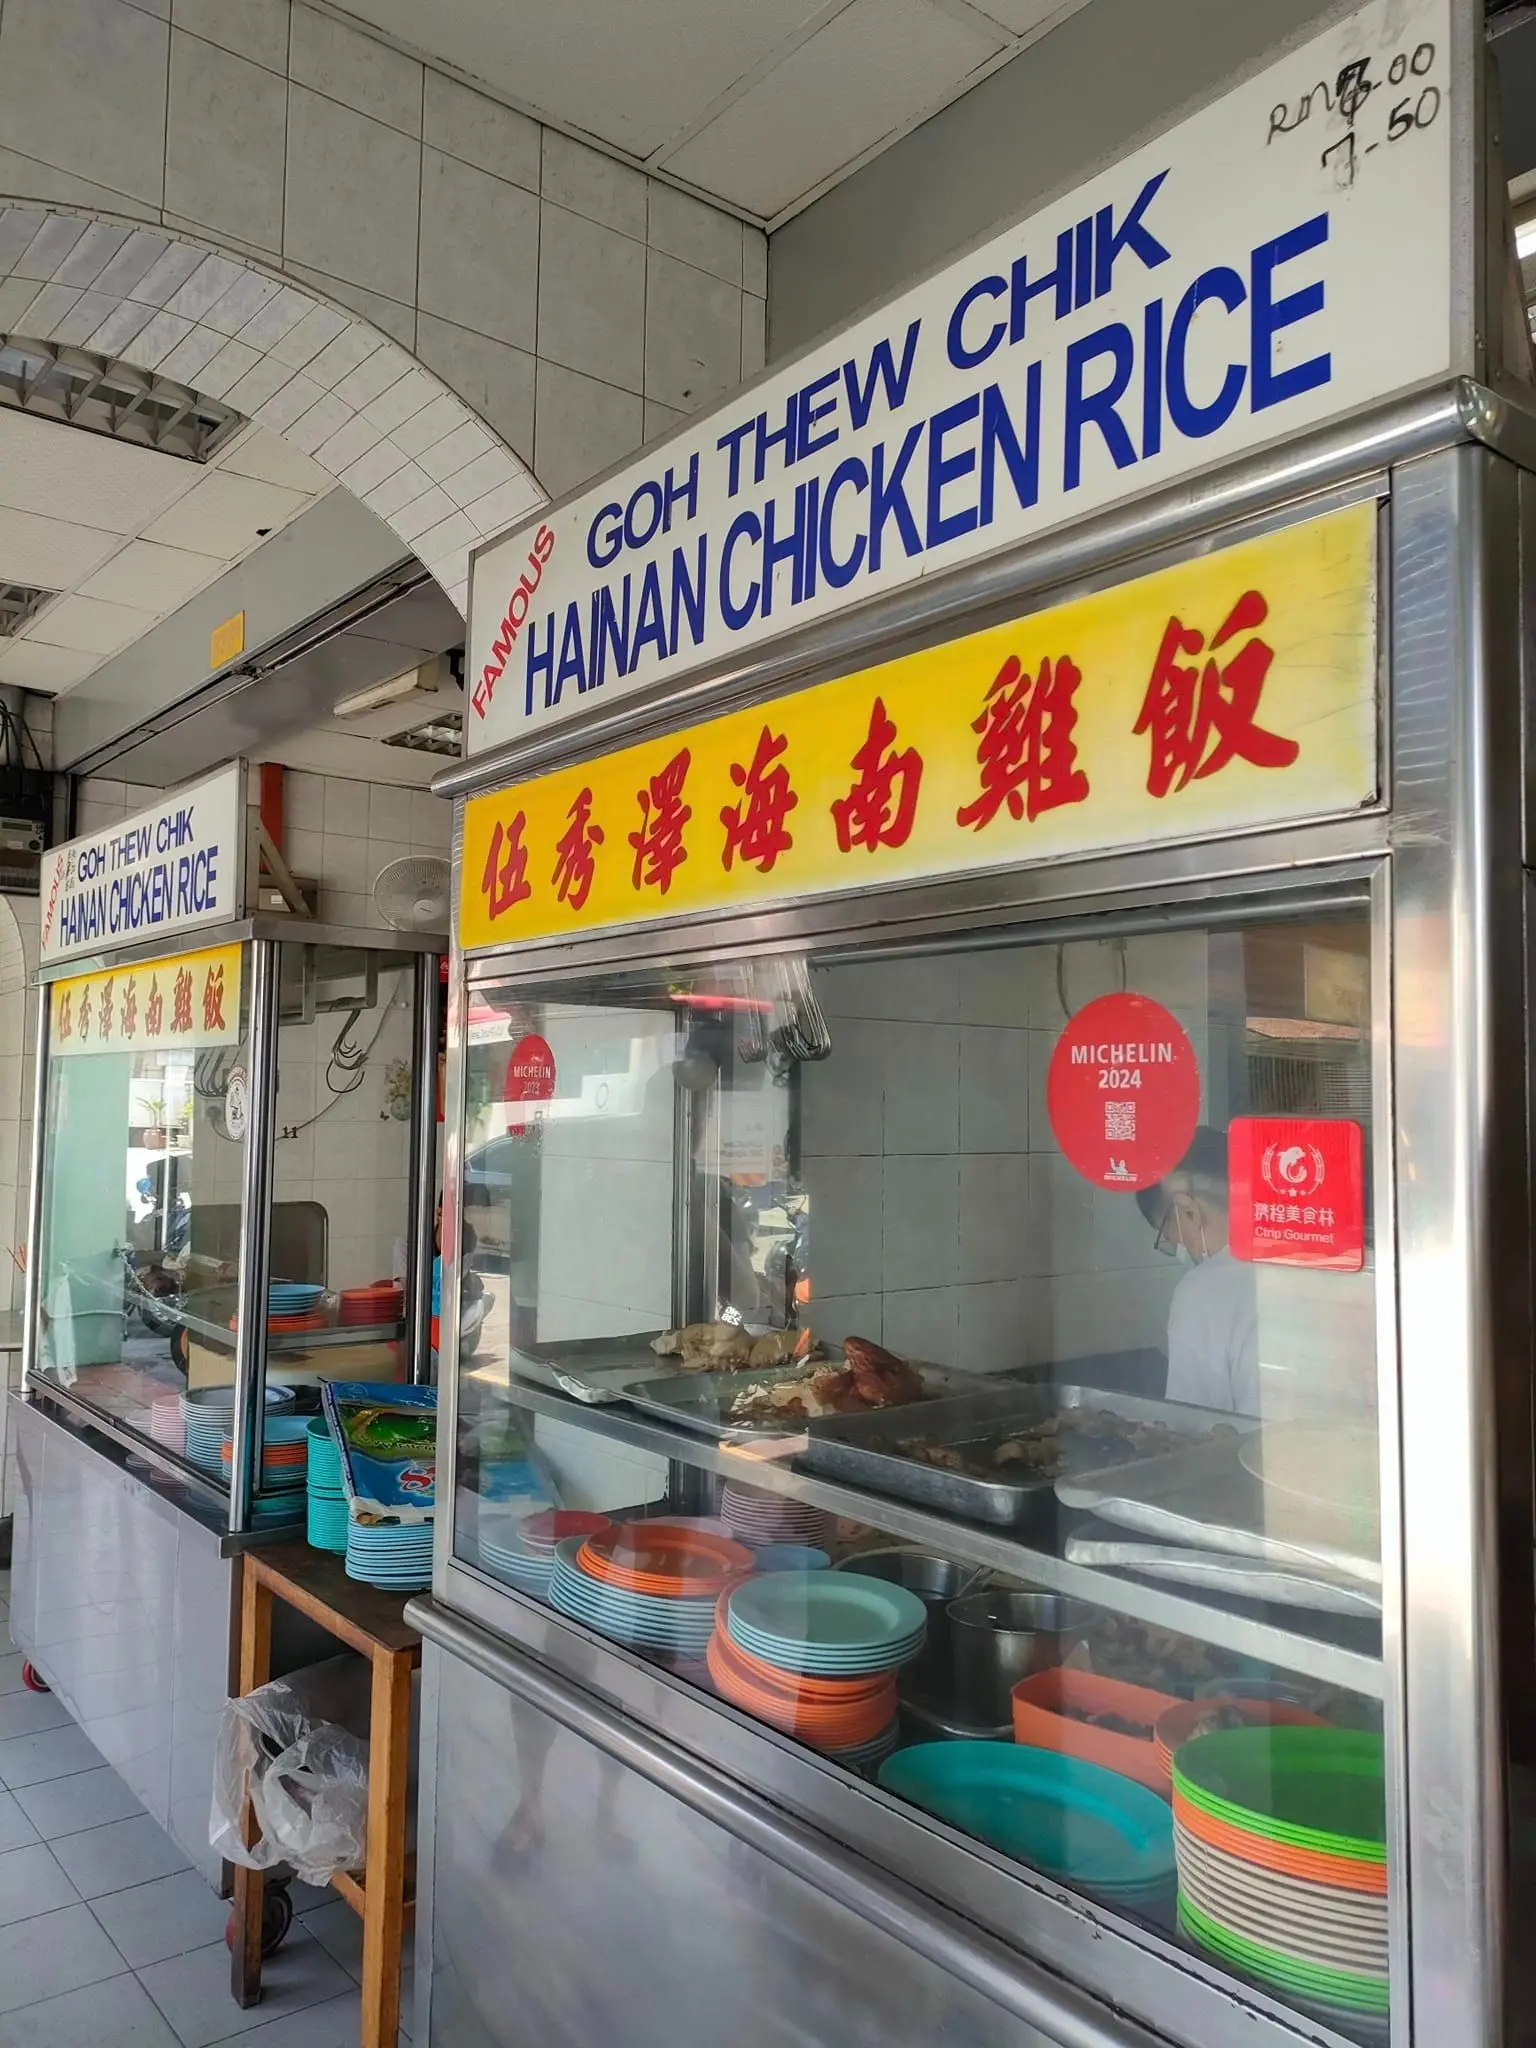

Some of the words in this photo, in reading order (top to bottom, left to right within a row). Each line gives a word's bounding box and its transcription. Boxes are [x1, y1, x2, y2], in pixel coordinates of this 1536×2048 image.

[586, 451, 700, 569] GOH
[716, 318, 922, 499] THEW
[946, 167, 1172, 370] CHIK
[525, 533, 708, 717] HAINAN
[719, 359, 1042, 632] CHICKEN
[1063, 211, 1332, 493] RICE
[471, 523, 556, 720] FAMOUS
[77, 843, 106, 883] GOH
[109, 823, 153, 872] THEW
[156, 805, 195, 854] CHIK
[60, 883, 107, 948] HAINAN
[109, 860, 175, 934] CHICKEN
[176, 845, 219, 917] RICE
[513, 1065, 551, 1079] MICHELIN
[1071, 1043, 1172, 1065] MICHELIN
[1098, 1068, 1142, 1089] 2024
[1254, 1226, 1281, 1240] Ctrip
[1283, 1228, 1335, 1245] Gourmet
